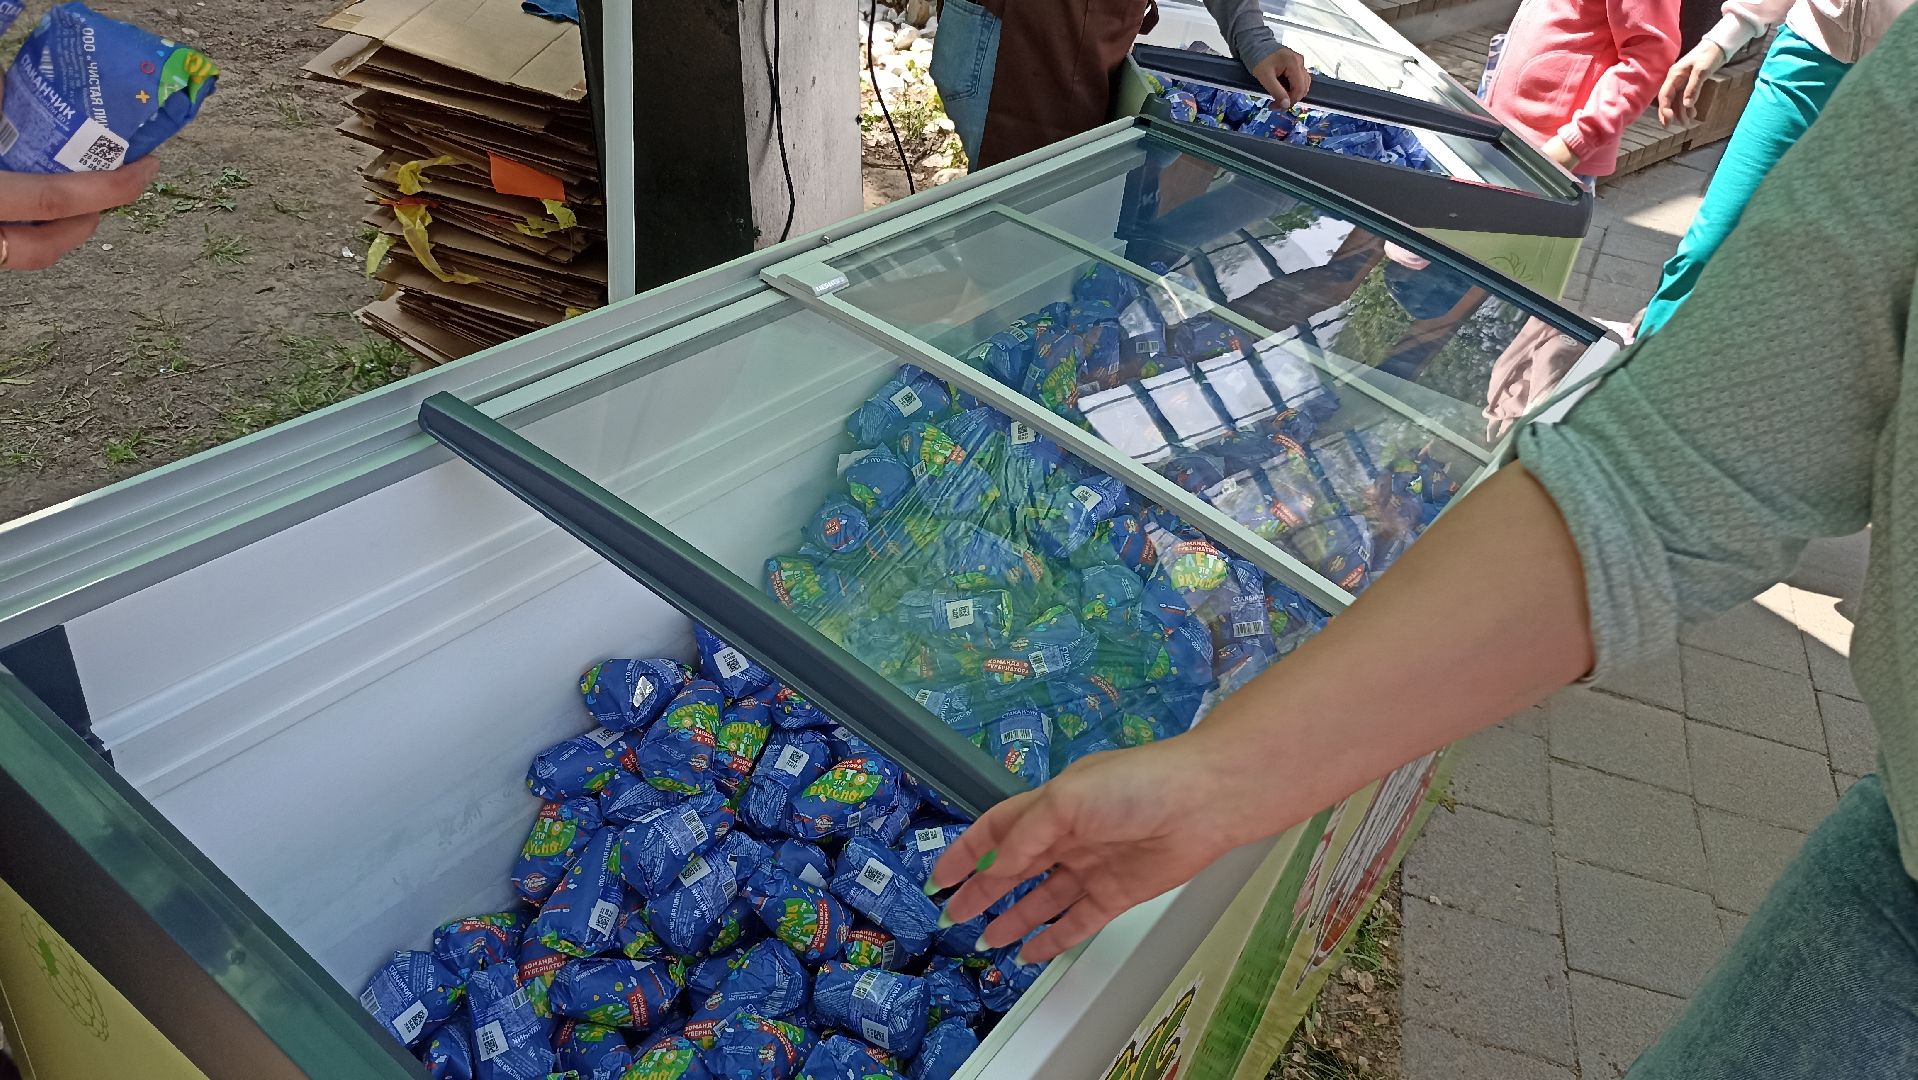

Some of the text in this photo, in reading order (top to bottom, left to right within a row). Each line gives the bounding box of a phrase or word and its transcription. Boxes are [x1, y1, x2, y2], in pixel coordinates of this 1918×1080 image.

[82, 27, 96, 52] ООО
[20, 54, 76, 120] СТАКАНЧИК
[87, 62, 105, 107] ЧИСТАЯ
[809, 784, 865, 802] ВКУСНО!
[523, 956, 558, 970] КОМАНДА
[388, 964, 415, 1001] СТАКАНЧИК
